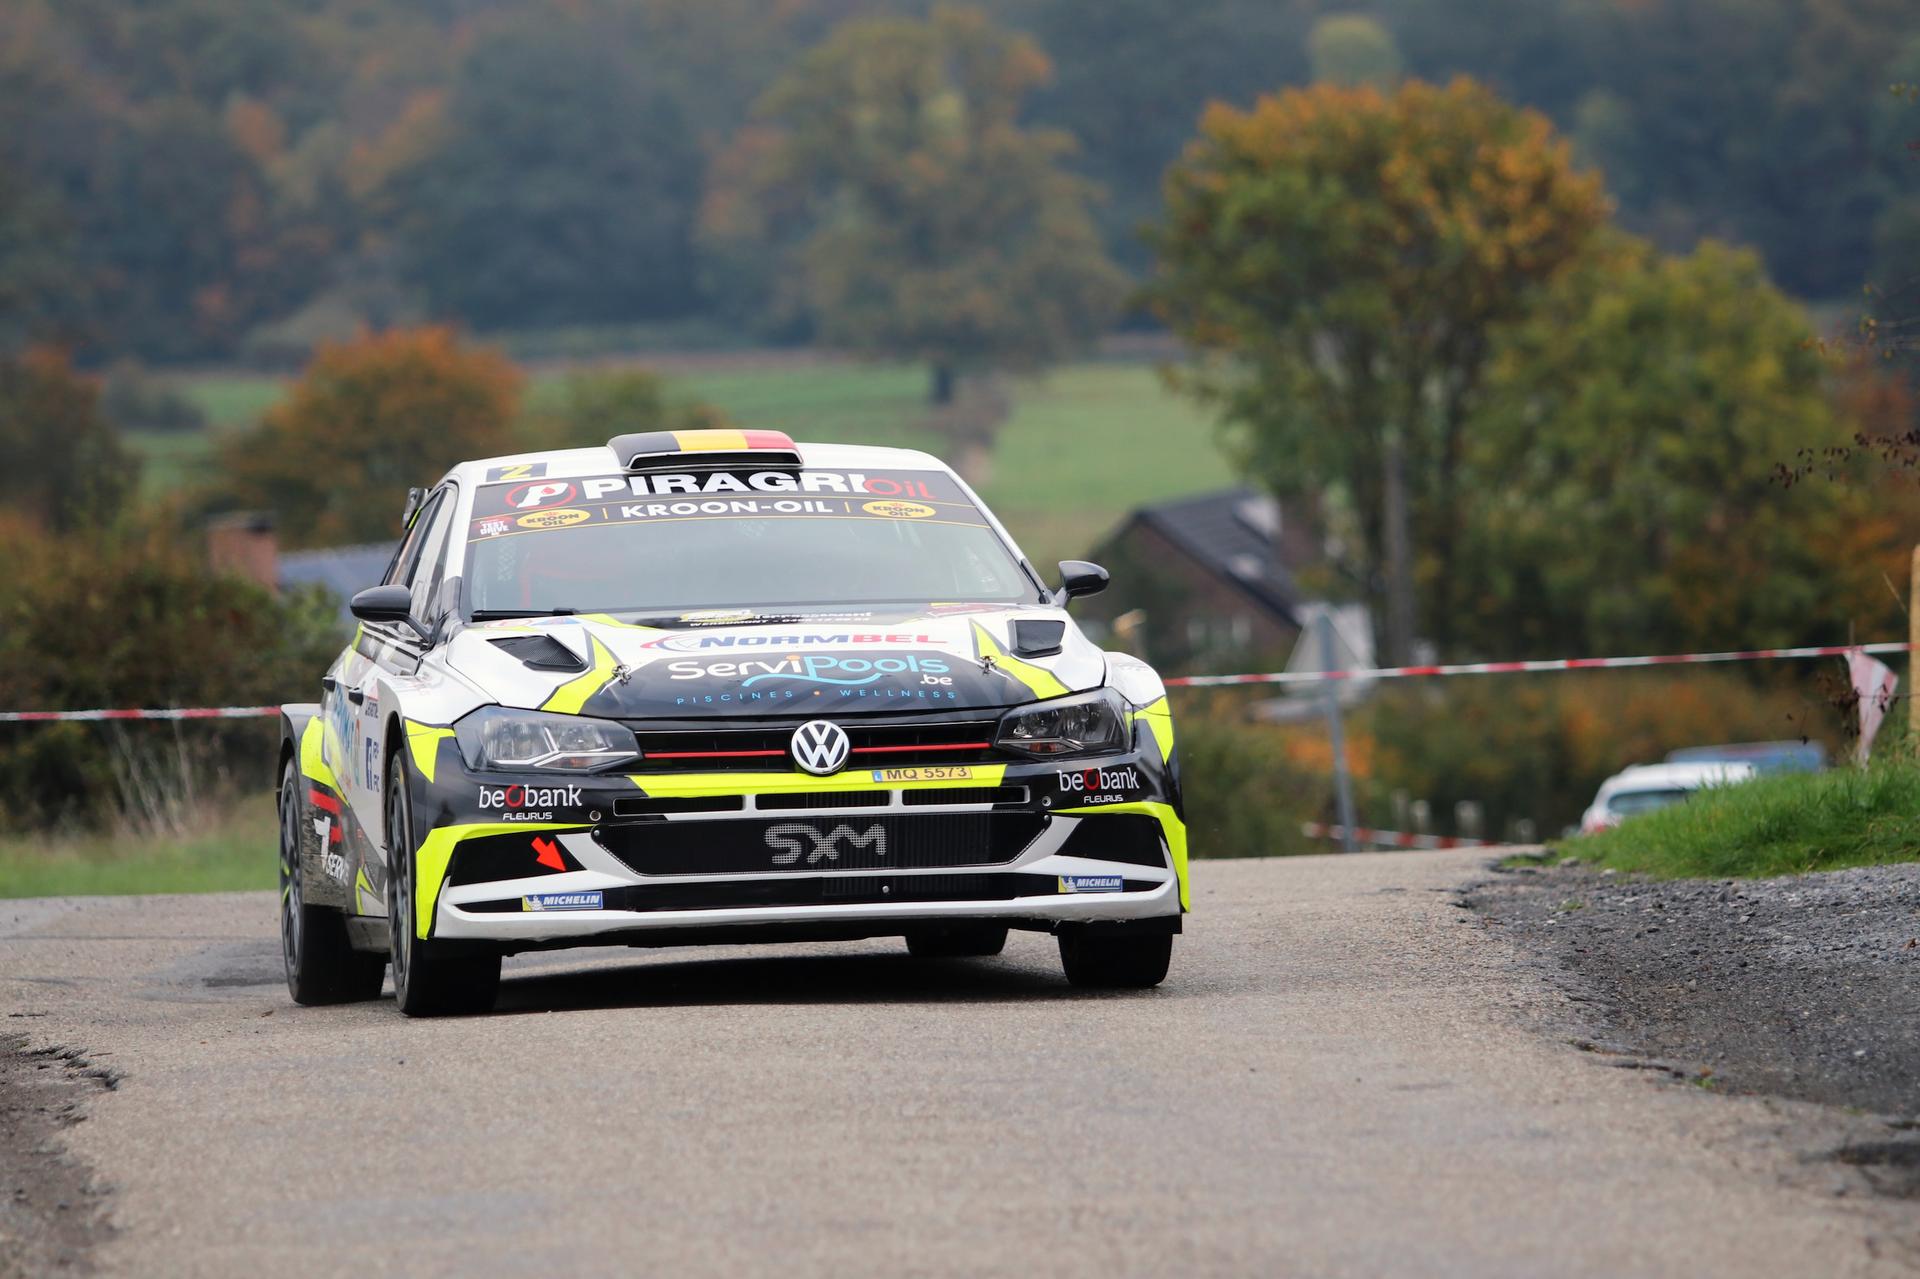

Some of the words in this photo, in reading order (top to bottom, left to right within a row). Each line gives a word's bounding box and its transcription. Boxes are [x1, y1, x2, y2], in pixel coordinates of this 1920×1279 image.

[500, 464, 533, 480] 2
[621, 500, 833, 518] KROON-OIL
[873, 505, 925, 513] KROON
[526, 512, 580, 524] KROON
[700, 633, 948, 648] NORMBEL
[667, 654, 951, 681] ServiPools
[677, 690, 793, 705] PISCINES
[840, 689, 957, 699] WELLNESS
[887, 769, 918, 780] MQ
[924, 767, 967, 779] 5573
[1083, 794, 1125, 804] FLEURUS
[502, 811, 553, 821] FLEURUS
[764, 823, 887, 864] SXM
[1076, 878, 1121, 888] MICHELIN
[543, 895, 601, 905] MICHELIN
